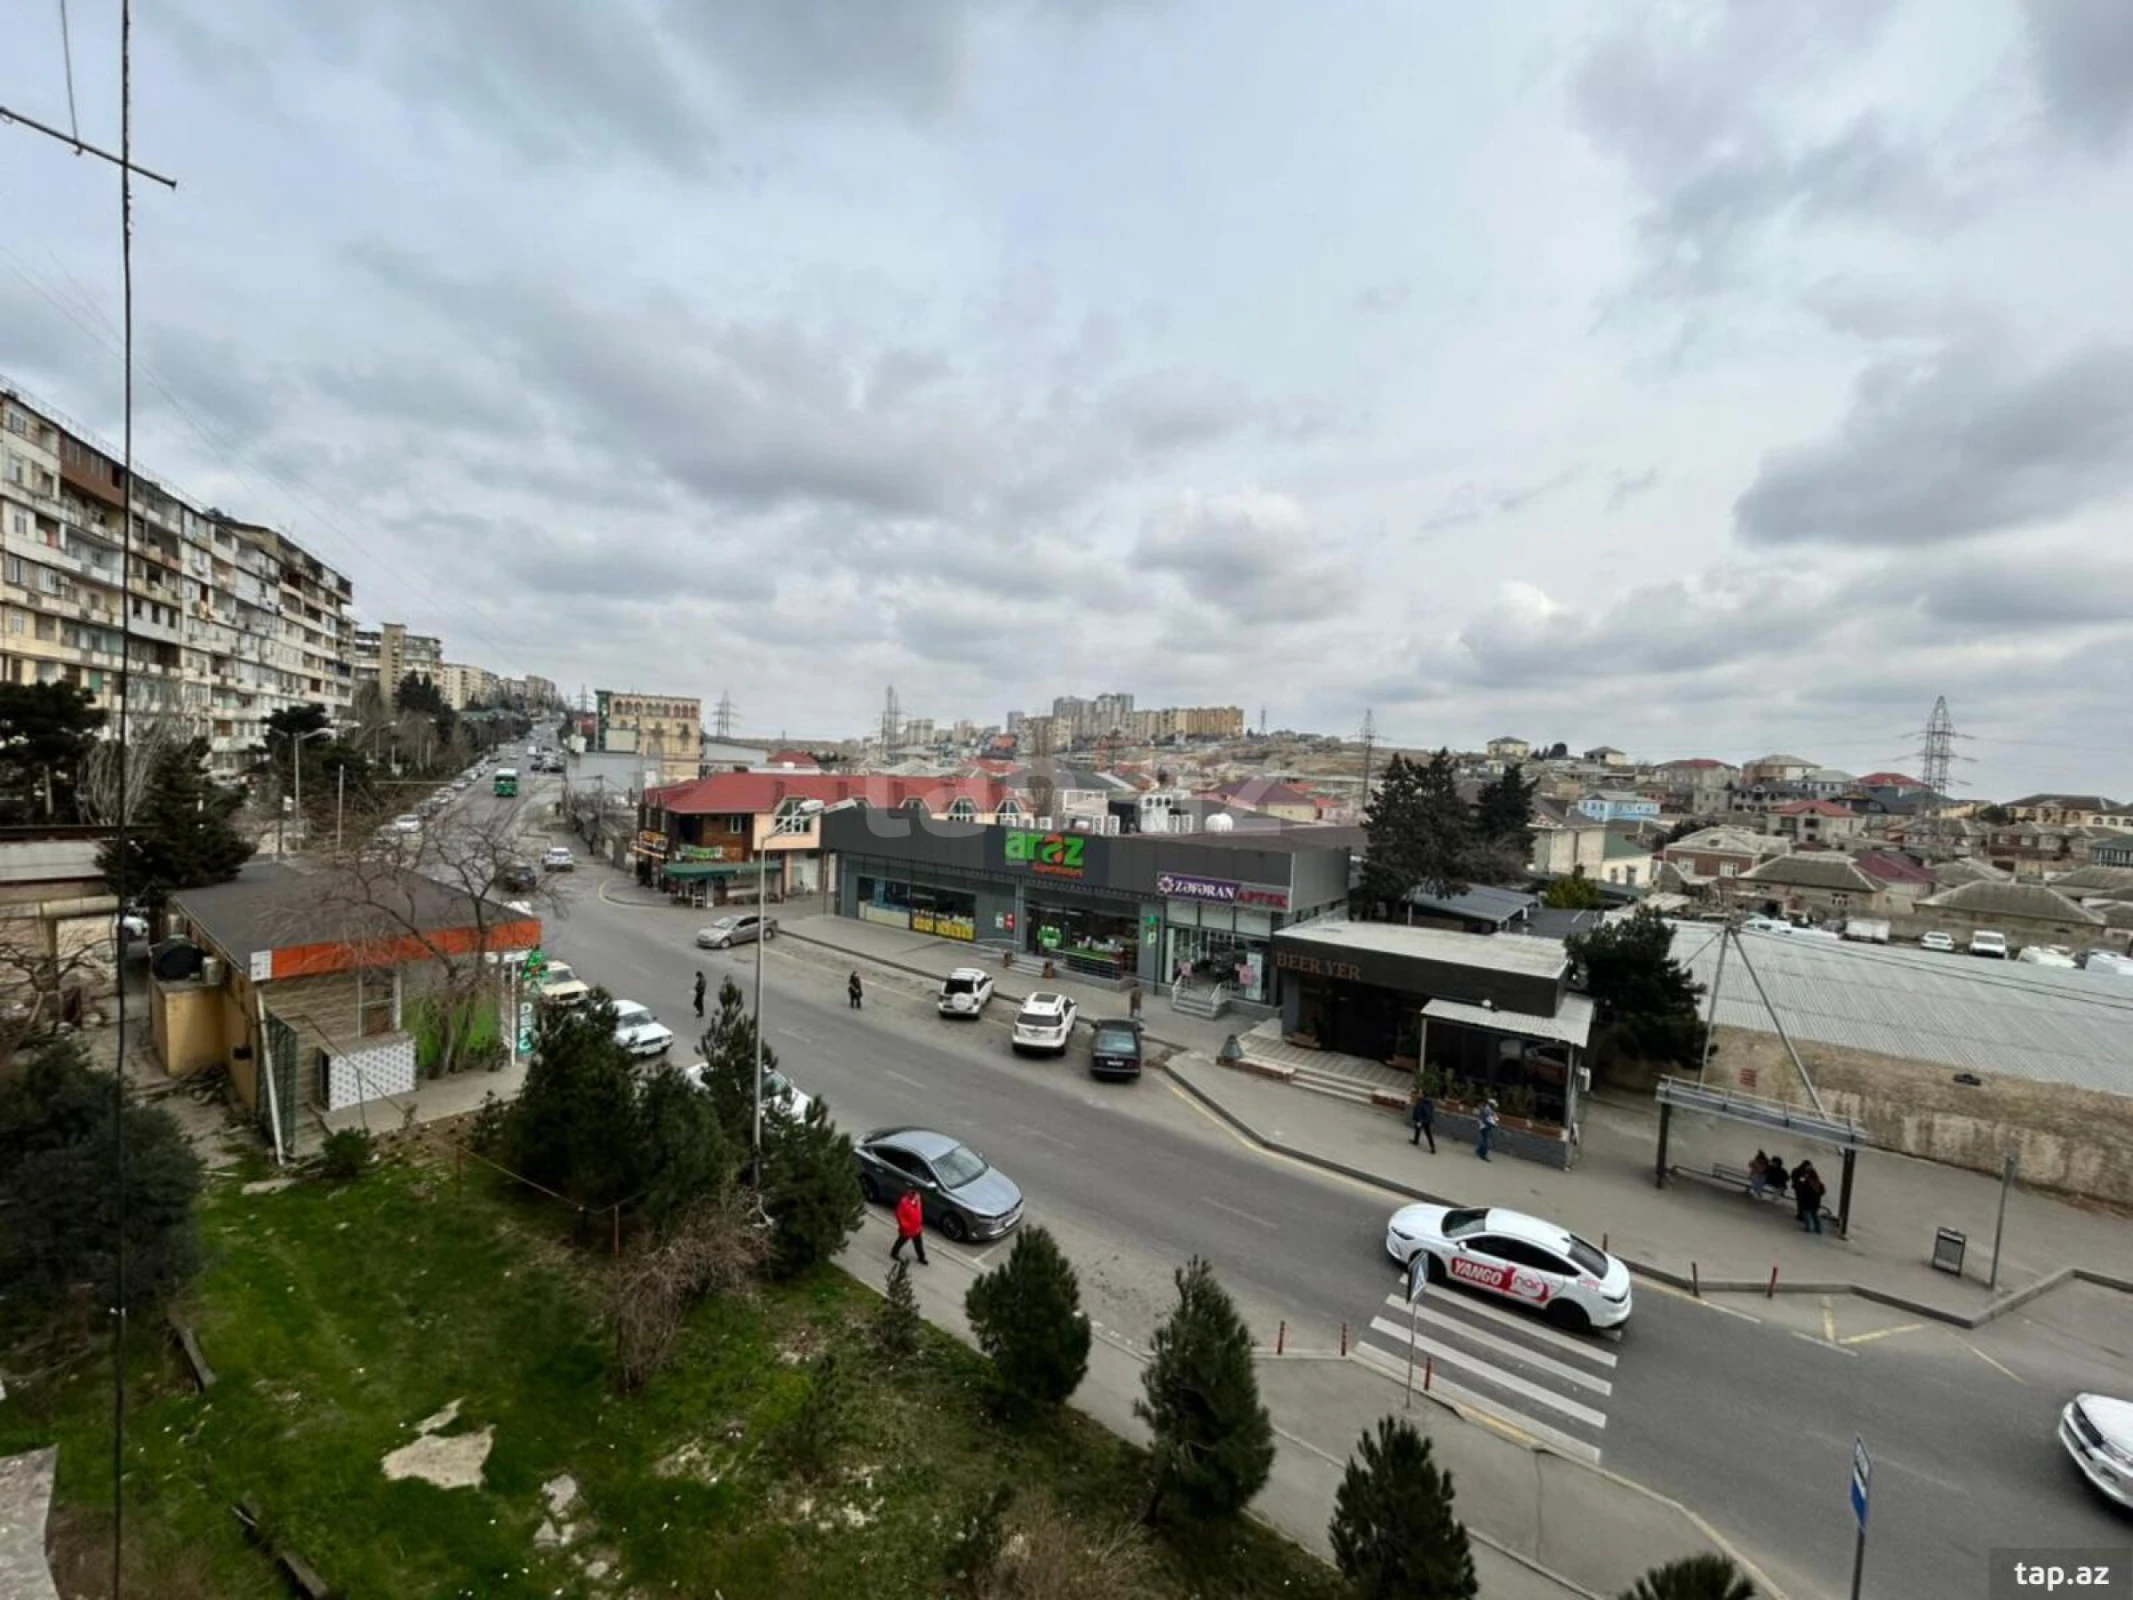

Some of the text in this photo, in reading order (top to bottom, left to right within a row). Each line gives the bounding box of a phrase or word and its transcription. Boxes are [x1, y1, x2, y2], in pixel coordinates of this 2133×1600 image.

[1005, 831, 1084, 866] araz
[1174, 879, 1235, 899] ZƏFƏRAN
[1276, 951, 1361, 980] BEER YER
[1454, 1259, 1503, 1286] YANGO
